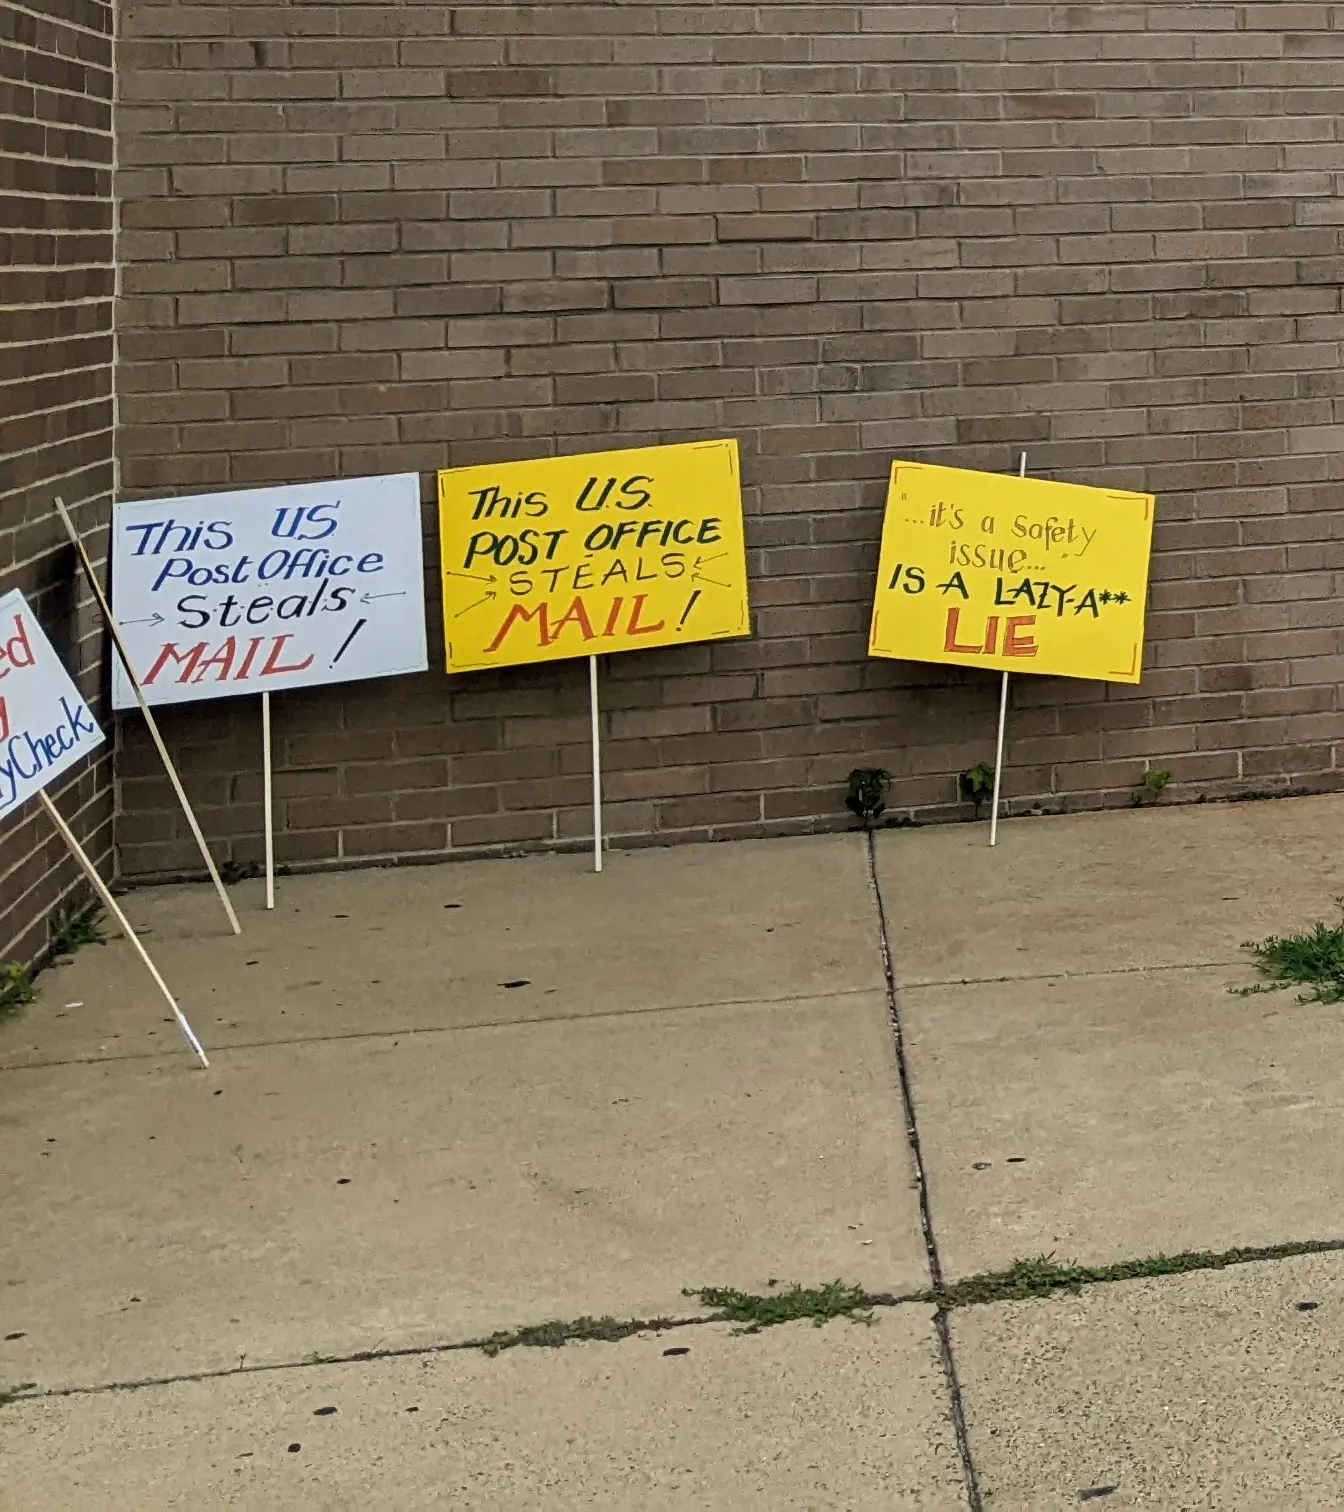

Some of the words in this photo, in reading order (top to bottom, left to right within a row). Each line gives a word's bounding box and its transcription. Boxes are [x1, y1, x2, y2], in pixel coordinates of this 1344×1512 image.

[463, 528, 569, 569] POST
[583, 517, 722, 551] OFFICE
[981, 515, 995, 534] a
[509, 552, 685, 595] STEALS
[888, 563, 926, 594] IS
[935, 571, 970, 600] A
[176, 578, 357, 629] Steals
[482, 590, 701, 653] MAIL!
[139, 618, 367, 686] MAIL!
[943, 607, 1039, 657] LIE
